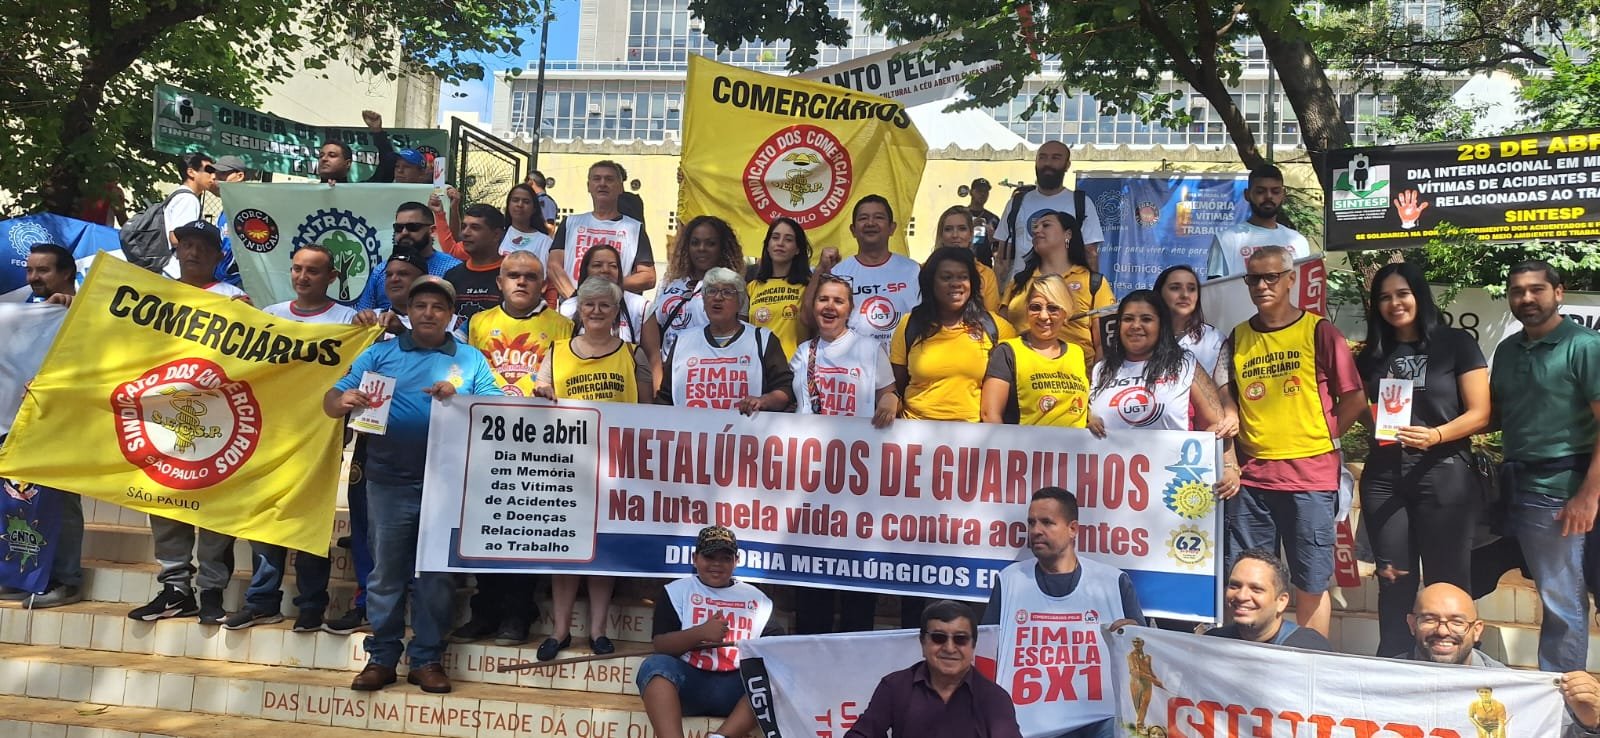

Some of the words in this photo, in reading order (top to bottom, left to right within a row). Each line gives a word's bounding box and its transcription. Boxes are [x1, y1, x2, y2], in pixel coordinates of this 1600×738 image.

[712, 76, 912, 129] COMERCIÁRIOS
[219, 107, 287, 136] CHEGA
[1457, 143, 1491, 161] 28
[1500, 138, 1538, 158] DE
[748, 145, 777, 210] SINDICATO
[776, 130, 802, 150] DOS
[806, 130, 851, 217] COMERCIÁRIOS
[1407, 168, 1431, 180] DIA
[1434, 160, 1552, 178] INTERNACIONAL
[1556, 157, 1579, 169] EM
[1418, 180, 1475, 194] VÍTIMAS
[1479, 178, 1499, 191] DE
[1502, 172, 1587, 189] ACIDENTES
[1183, 198, 1236, 211] MEMÓRIA
[1335, 198, 1387, 209] SINTESP
[1436, 190, 1548, 208] RELACIONADAS
[1551, 189, 1573, 201] AO
[1505, 207, 1585, 223] SINTESP
[238, 233, 279, 253] SINDICAL
[1305, 265, 1323, 313] UGT
[871, 313, 891, 321] UGT
[492, 347, 538, 368] BLOCO
[1242, 352, 1285, 370] SINDICATO
[566, 372, 608, 387] SINDICATO
[687, 367, 727, 383] FIM
[729, 370, 748, 382] DA
[1241, 360, 1301, 379] COMERCIÁRIO
[567, 381, 625, 397] COMERCIÁRIOS
[685, 382, 749, 399] ESCALA
[117, 372, 160, 452] SINDICATO
[164, 363, 199, 381] DOS
[1123, 404, 1149, 414] UGT
[481, 415, 506, 442] 28
[512, 416, 537, 443] de
[542, 418, 588, 445] abril
[494, 450, 517, 461] Dia
[521, 451, 574, 464] Mundial
[607, 424, 870, 497] METALÚRGICOS
[879, 442, 923, 498] DE
[144, 455, 170, 474] SÃO
[170, 467, 209, 480] PAULO
[490, 467, 512, 476] em
[516, 466, 576, 478] Memória
[491, 480, 516, 491] das
[521, 481, 574, 493] Vítimas
[126, 486, 153, 503] SÃO
[157, 494, 200, 511] PAULO
[485, 494, 502, 505] de
[506, 495, 577, 508] Acidentes
[493, 512, 501, 521] e
[506, 510, 567, 524] Doenças
[608, 488, 646, 522] Na
[652, 490, 709, 525] luta
[715, 499, 778, 532] pela
[785, 502, 849, 538] vida
[855, 511, 875, 539] e
[880, 513, 982, 547] contra
[480, 524, 577, 538] Relacionadas
[485, 542, 503, 551] ao
[507, 540, 570, 553] Trabalho
[1175, 536, 1202, 551] 62
[1336, 533, 1356, 579] UGT
[790, 552, 971, 588] METALÚRGICOS
[1015, 626, 1069, 646] FIM
[1071, 630, 1097, 645] DA
[1013, 645, 1102, 668] ESCALA
[467, 655, 577, 679] LIBERDADE!
[583, 663, 633, 684] ABRE
[1011, 665, 1103, 706] 6X1
[747, 675, 772, 724] UGT
[264, 691, 299, 711] DAS
[306, 695, 366, 718] LUTAS
[374, 702, 400, 721] NA
[406, 704, 533, 734] TEMPESTADE
[540, 713, 568, 736] DÁ
[575, 718, 619, 738] QUE
